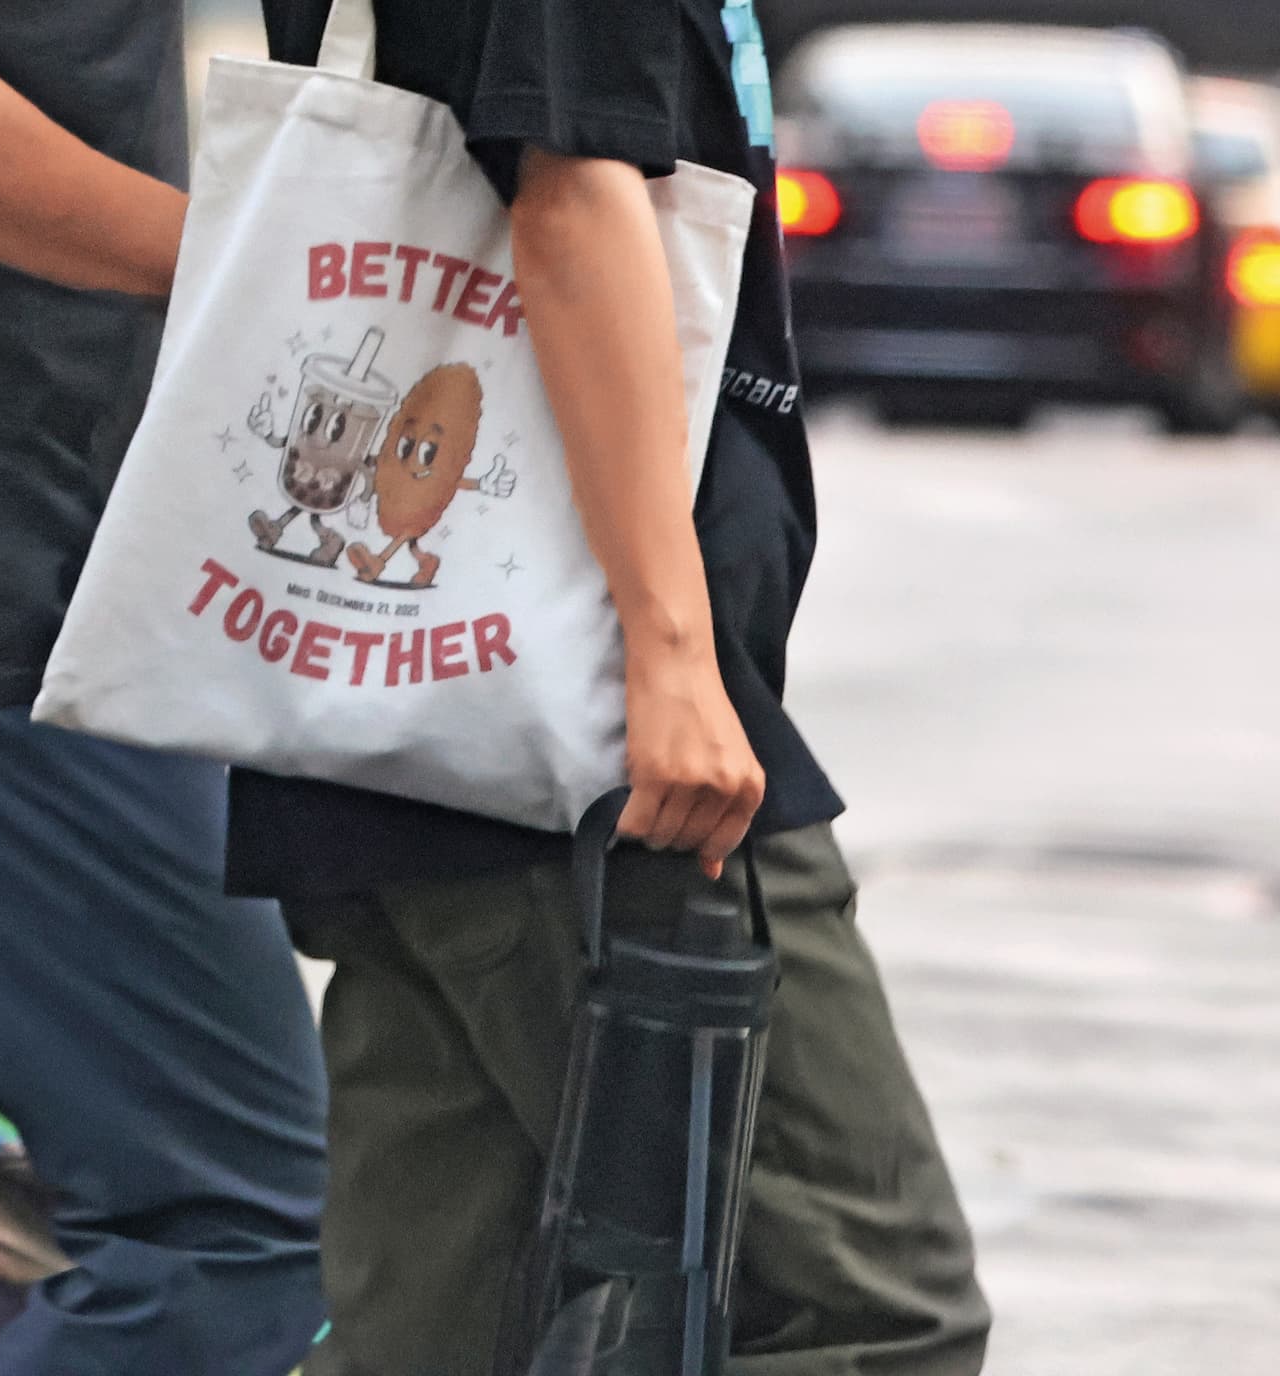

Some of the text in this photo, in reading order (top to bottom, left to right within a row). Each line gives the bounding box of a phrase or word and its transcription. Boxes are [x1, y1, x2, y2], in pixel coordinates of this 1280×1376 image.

[308, 241, 524, 337] BETTER
[187, 557, 518, 687] TOGETHER
[316, 589, 374, 613] DECEMBER
